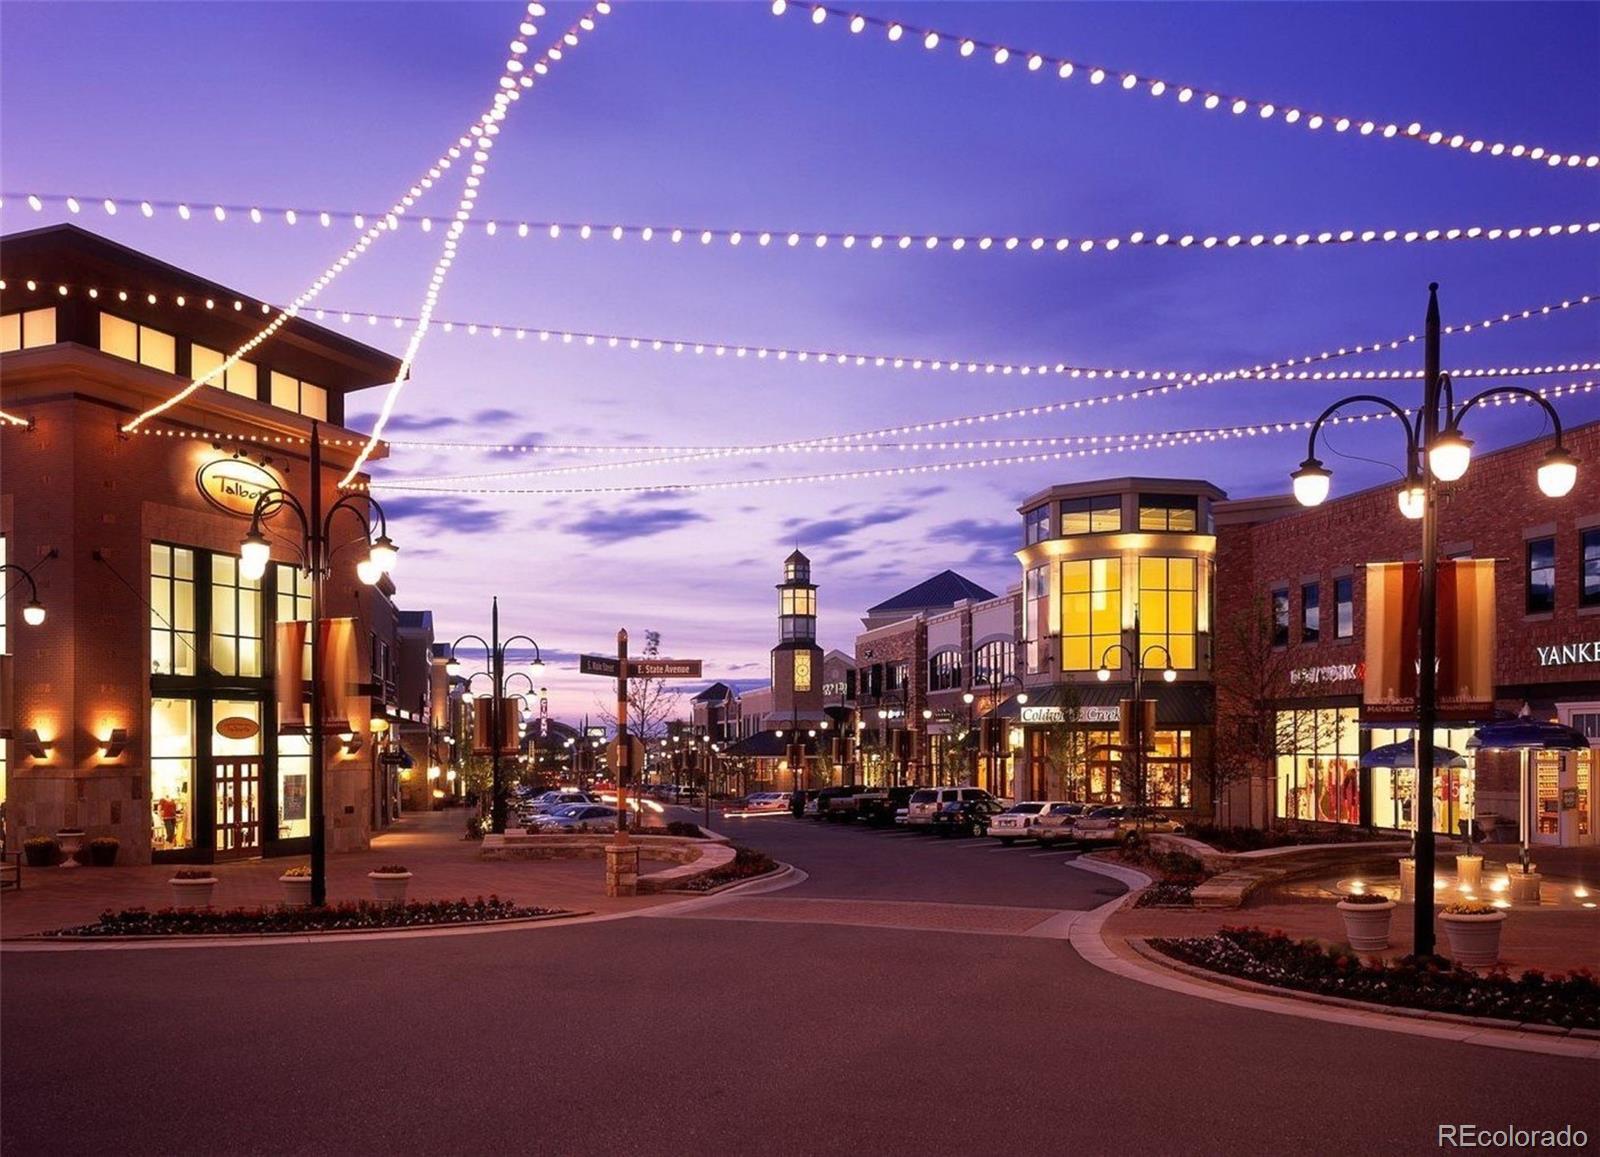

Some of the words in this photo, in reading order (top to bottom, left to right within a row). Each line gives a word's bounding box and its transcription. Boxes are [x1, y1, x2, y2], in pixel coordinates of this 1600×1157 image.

[1536, 641, 1600, 666] YANKE
[638, 664, 644, 674] E.
[645, 664, 664, 674] State
[664, 664, 690, 674] Avenue
[1022, 707, 1086, 721] Coldwr
[1087, 706, 1120, 722] Creek
